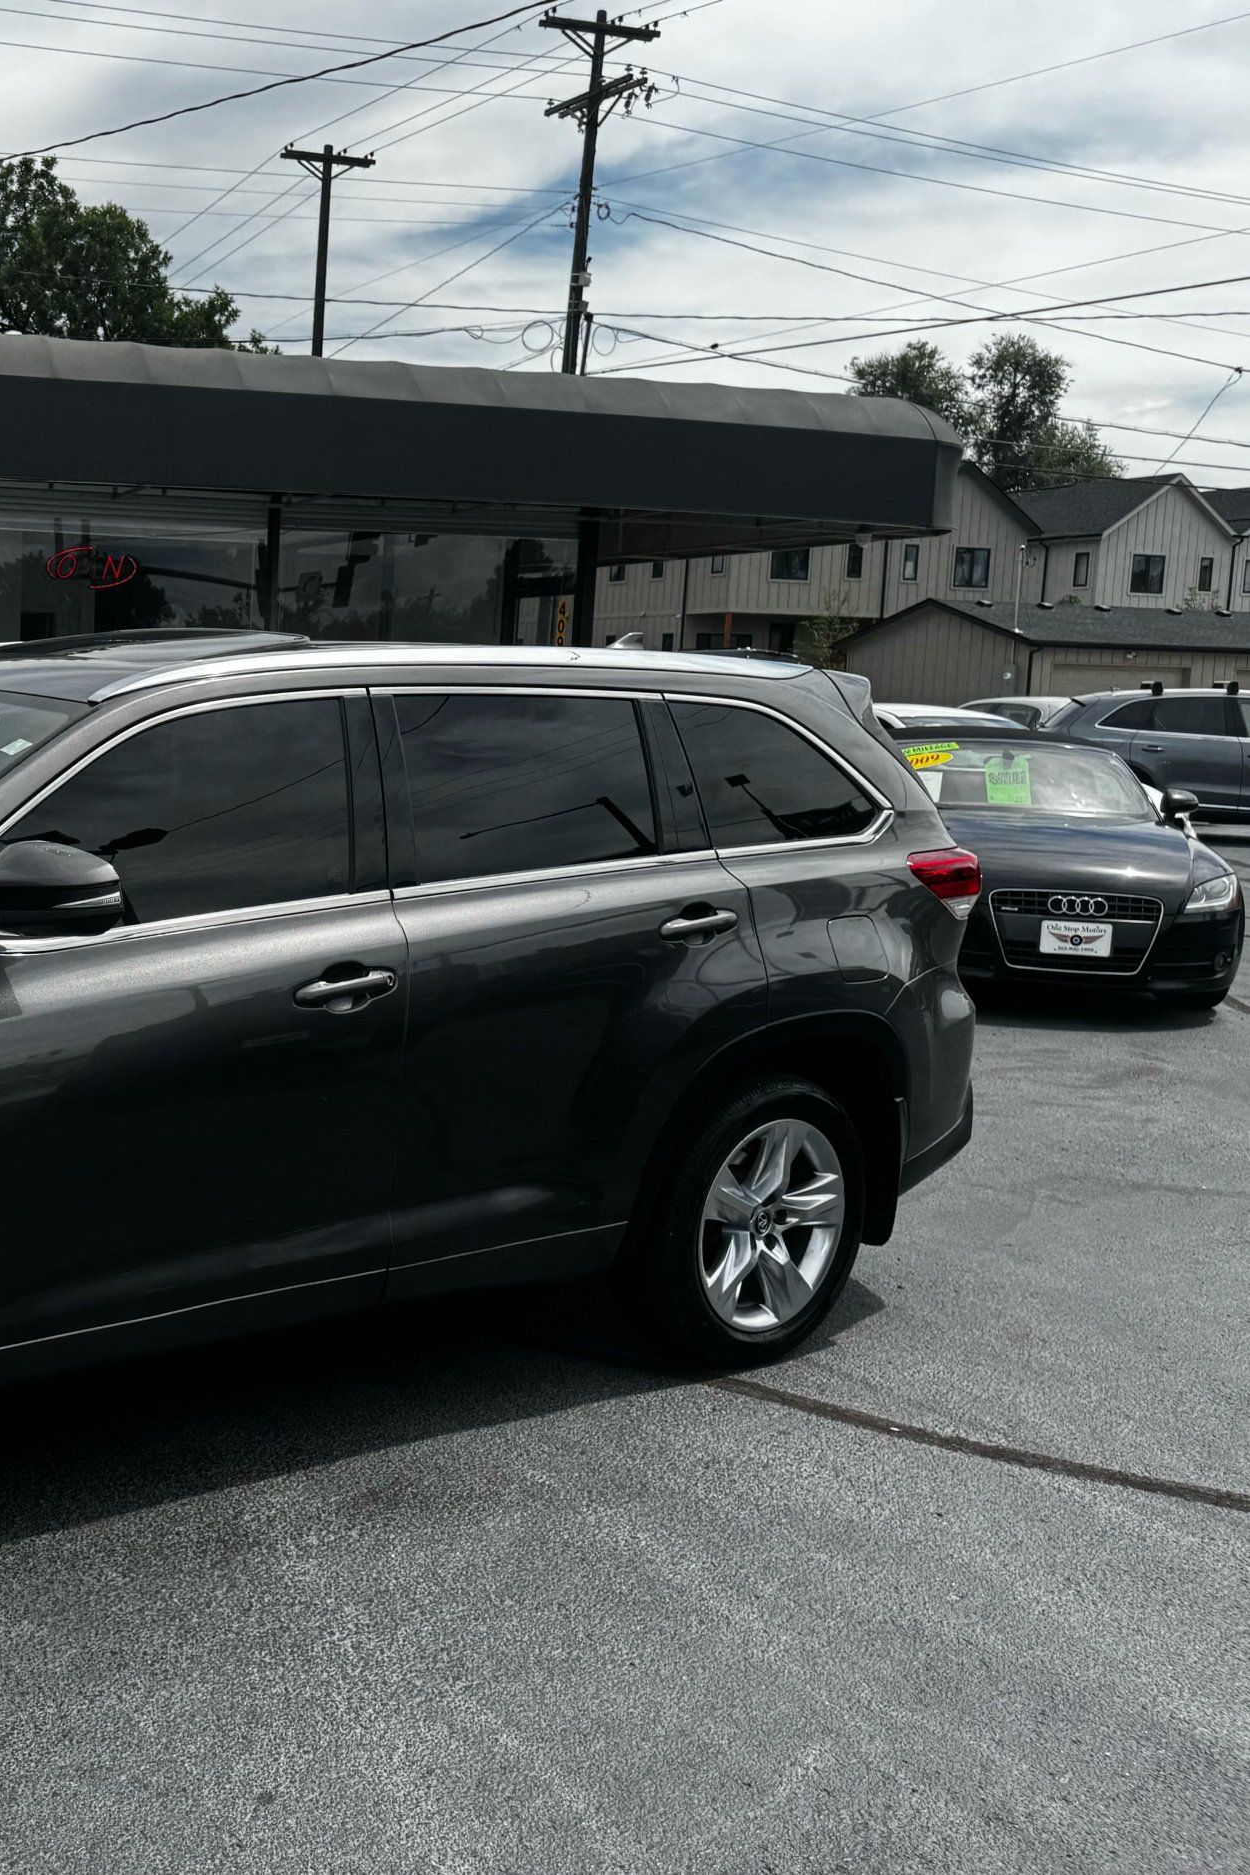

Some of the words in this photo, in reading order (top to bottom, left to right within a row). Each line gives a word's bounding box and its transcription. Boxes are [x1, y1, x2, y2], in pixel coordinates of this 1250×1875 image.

[910, 753, 940, 766] 009
[1063, 924, 1080, 933] Stop
[1081, 925, 1107, 934] Motors
